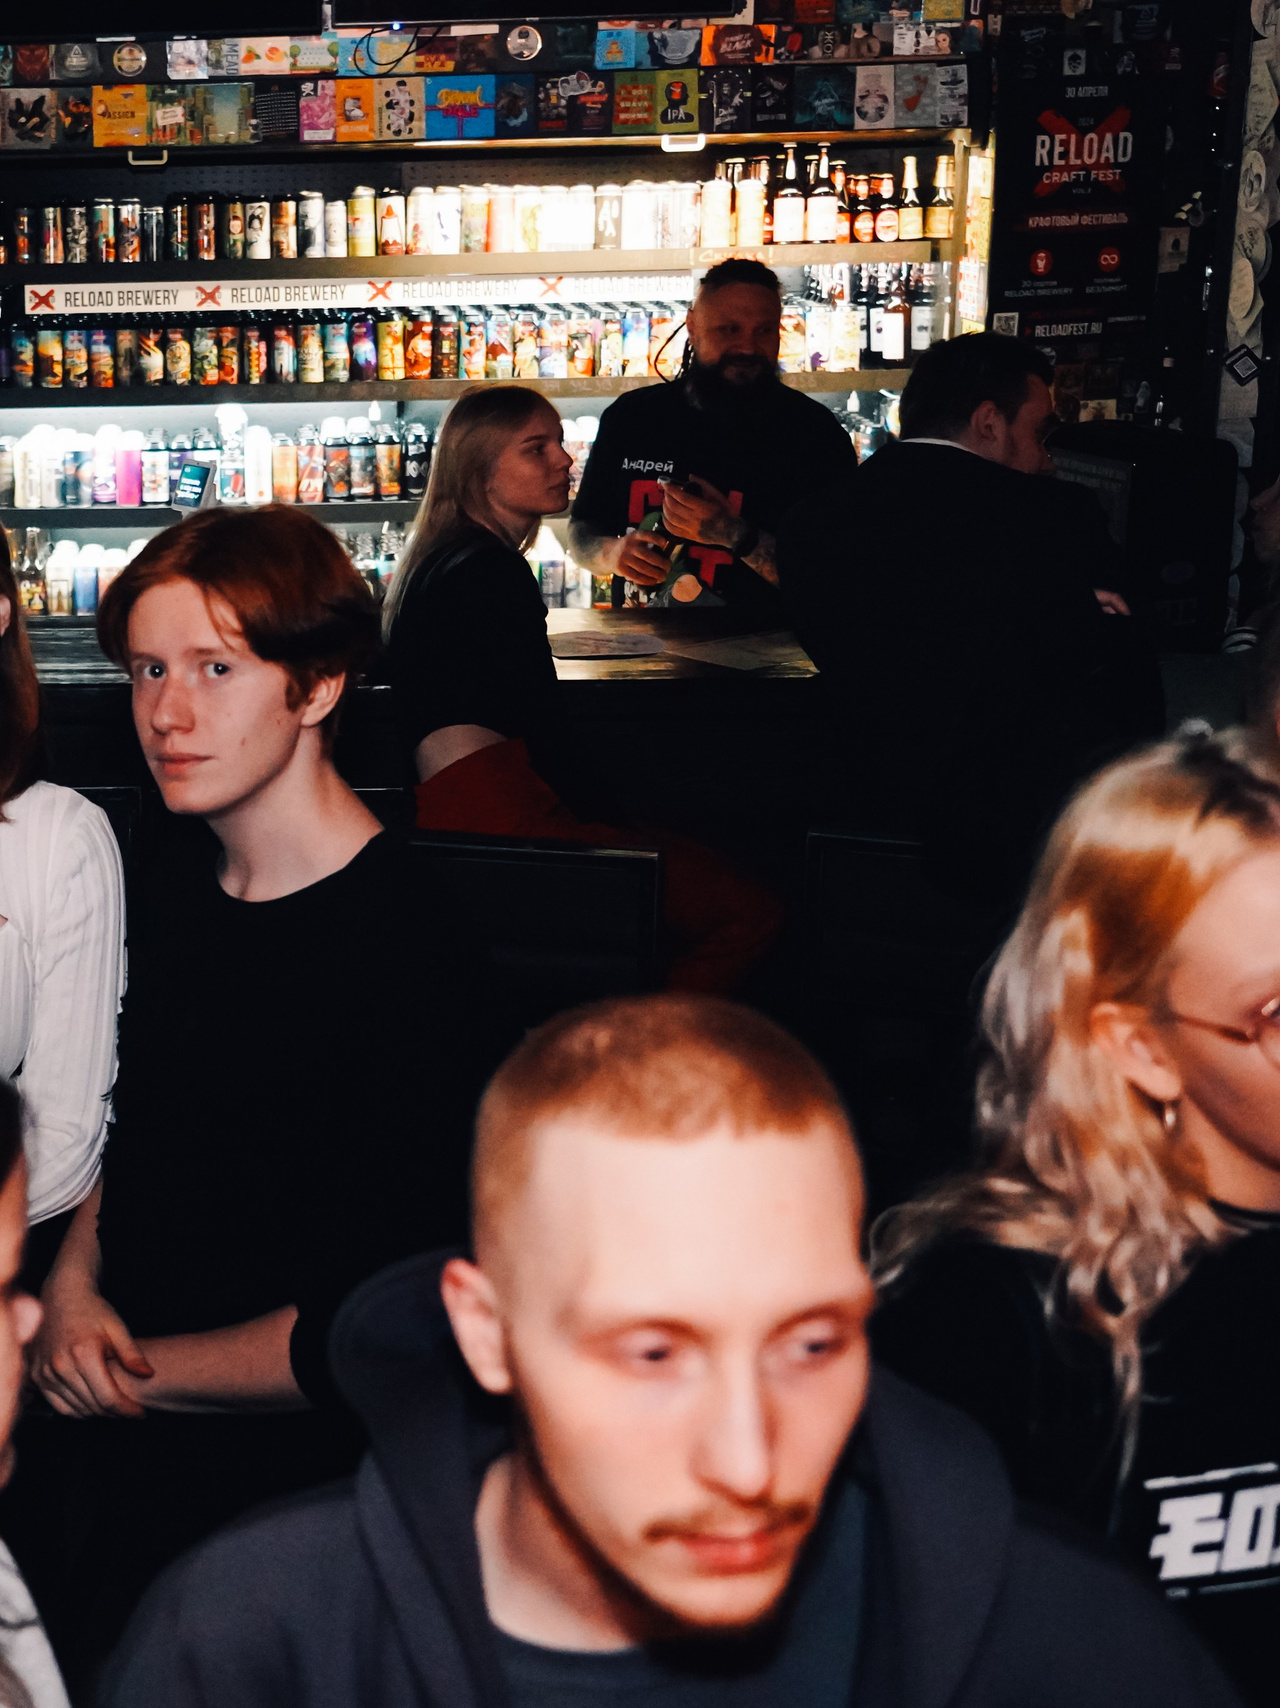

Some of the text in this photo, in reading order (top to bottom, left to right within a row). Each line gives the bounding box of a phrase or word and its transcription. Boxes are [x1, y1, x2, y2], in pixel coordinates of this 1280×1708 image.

[667, 107, 685, 121] IPA
[1035, 131, 1134, 167] RELOAD
[1042, 169, 1122, 183] CRAFT FEST
[1028, 212, 1128, 228] КРАФТОВЫЙ ФЕСТИВАЛЬ
[64, 291, 113, 307] RELOAD
[117, 289, 179, 306] BREWERY
[231, 286, 280, 304] RELOAD
[285, 284, 346, 302] BREWERY
[403, 281, 452, 299] RELOAD
[457, 279, 519, 298] BREWERY
[1035, 322, 1103, 337] RELOADFEST.RU
[622, 457, 674, 474] Андрей
